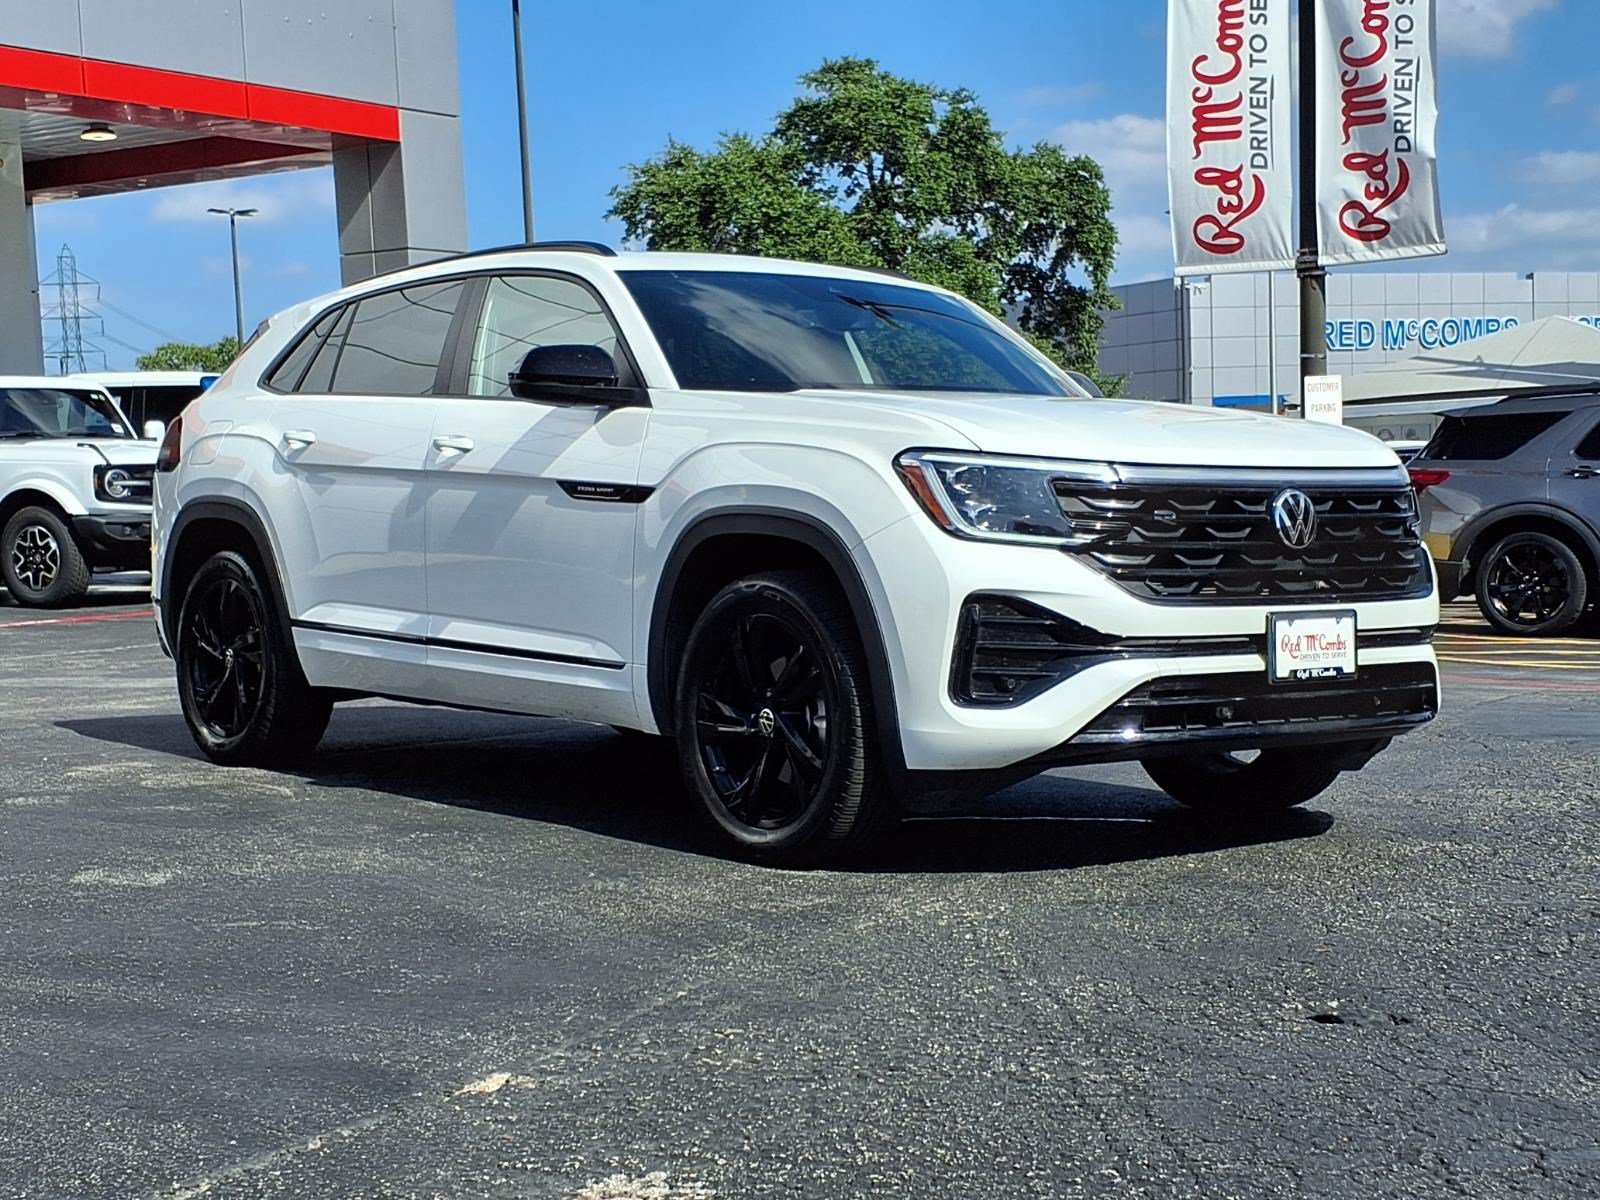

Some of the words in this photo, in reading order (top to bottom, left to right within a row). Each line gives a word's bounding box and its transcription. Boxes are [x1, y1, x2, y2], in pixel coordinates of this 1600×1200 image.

[1395, 14, 1414, 49] TO
[1249, 34, 1267, 68] TO
[1394, 58, 1413, 152] DRIVEN
[1250, 76, 1268, 169] DRIVEN
[1193, 164, 1265, 254] Red
[1339, 148, 1409, 242] Red
[1325, 321, 1374, 348] RED
[1307, 382, 1339, 392] CUSTOMER
[1311, 402, 1336, 413] PARKING
[1281, 634, 1301, 659] Red
[1297, 669, 1309, 679] Red
